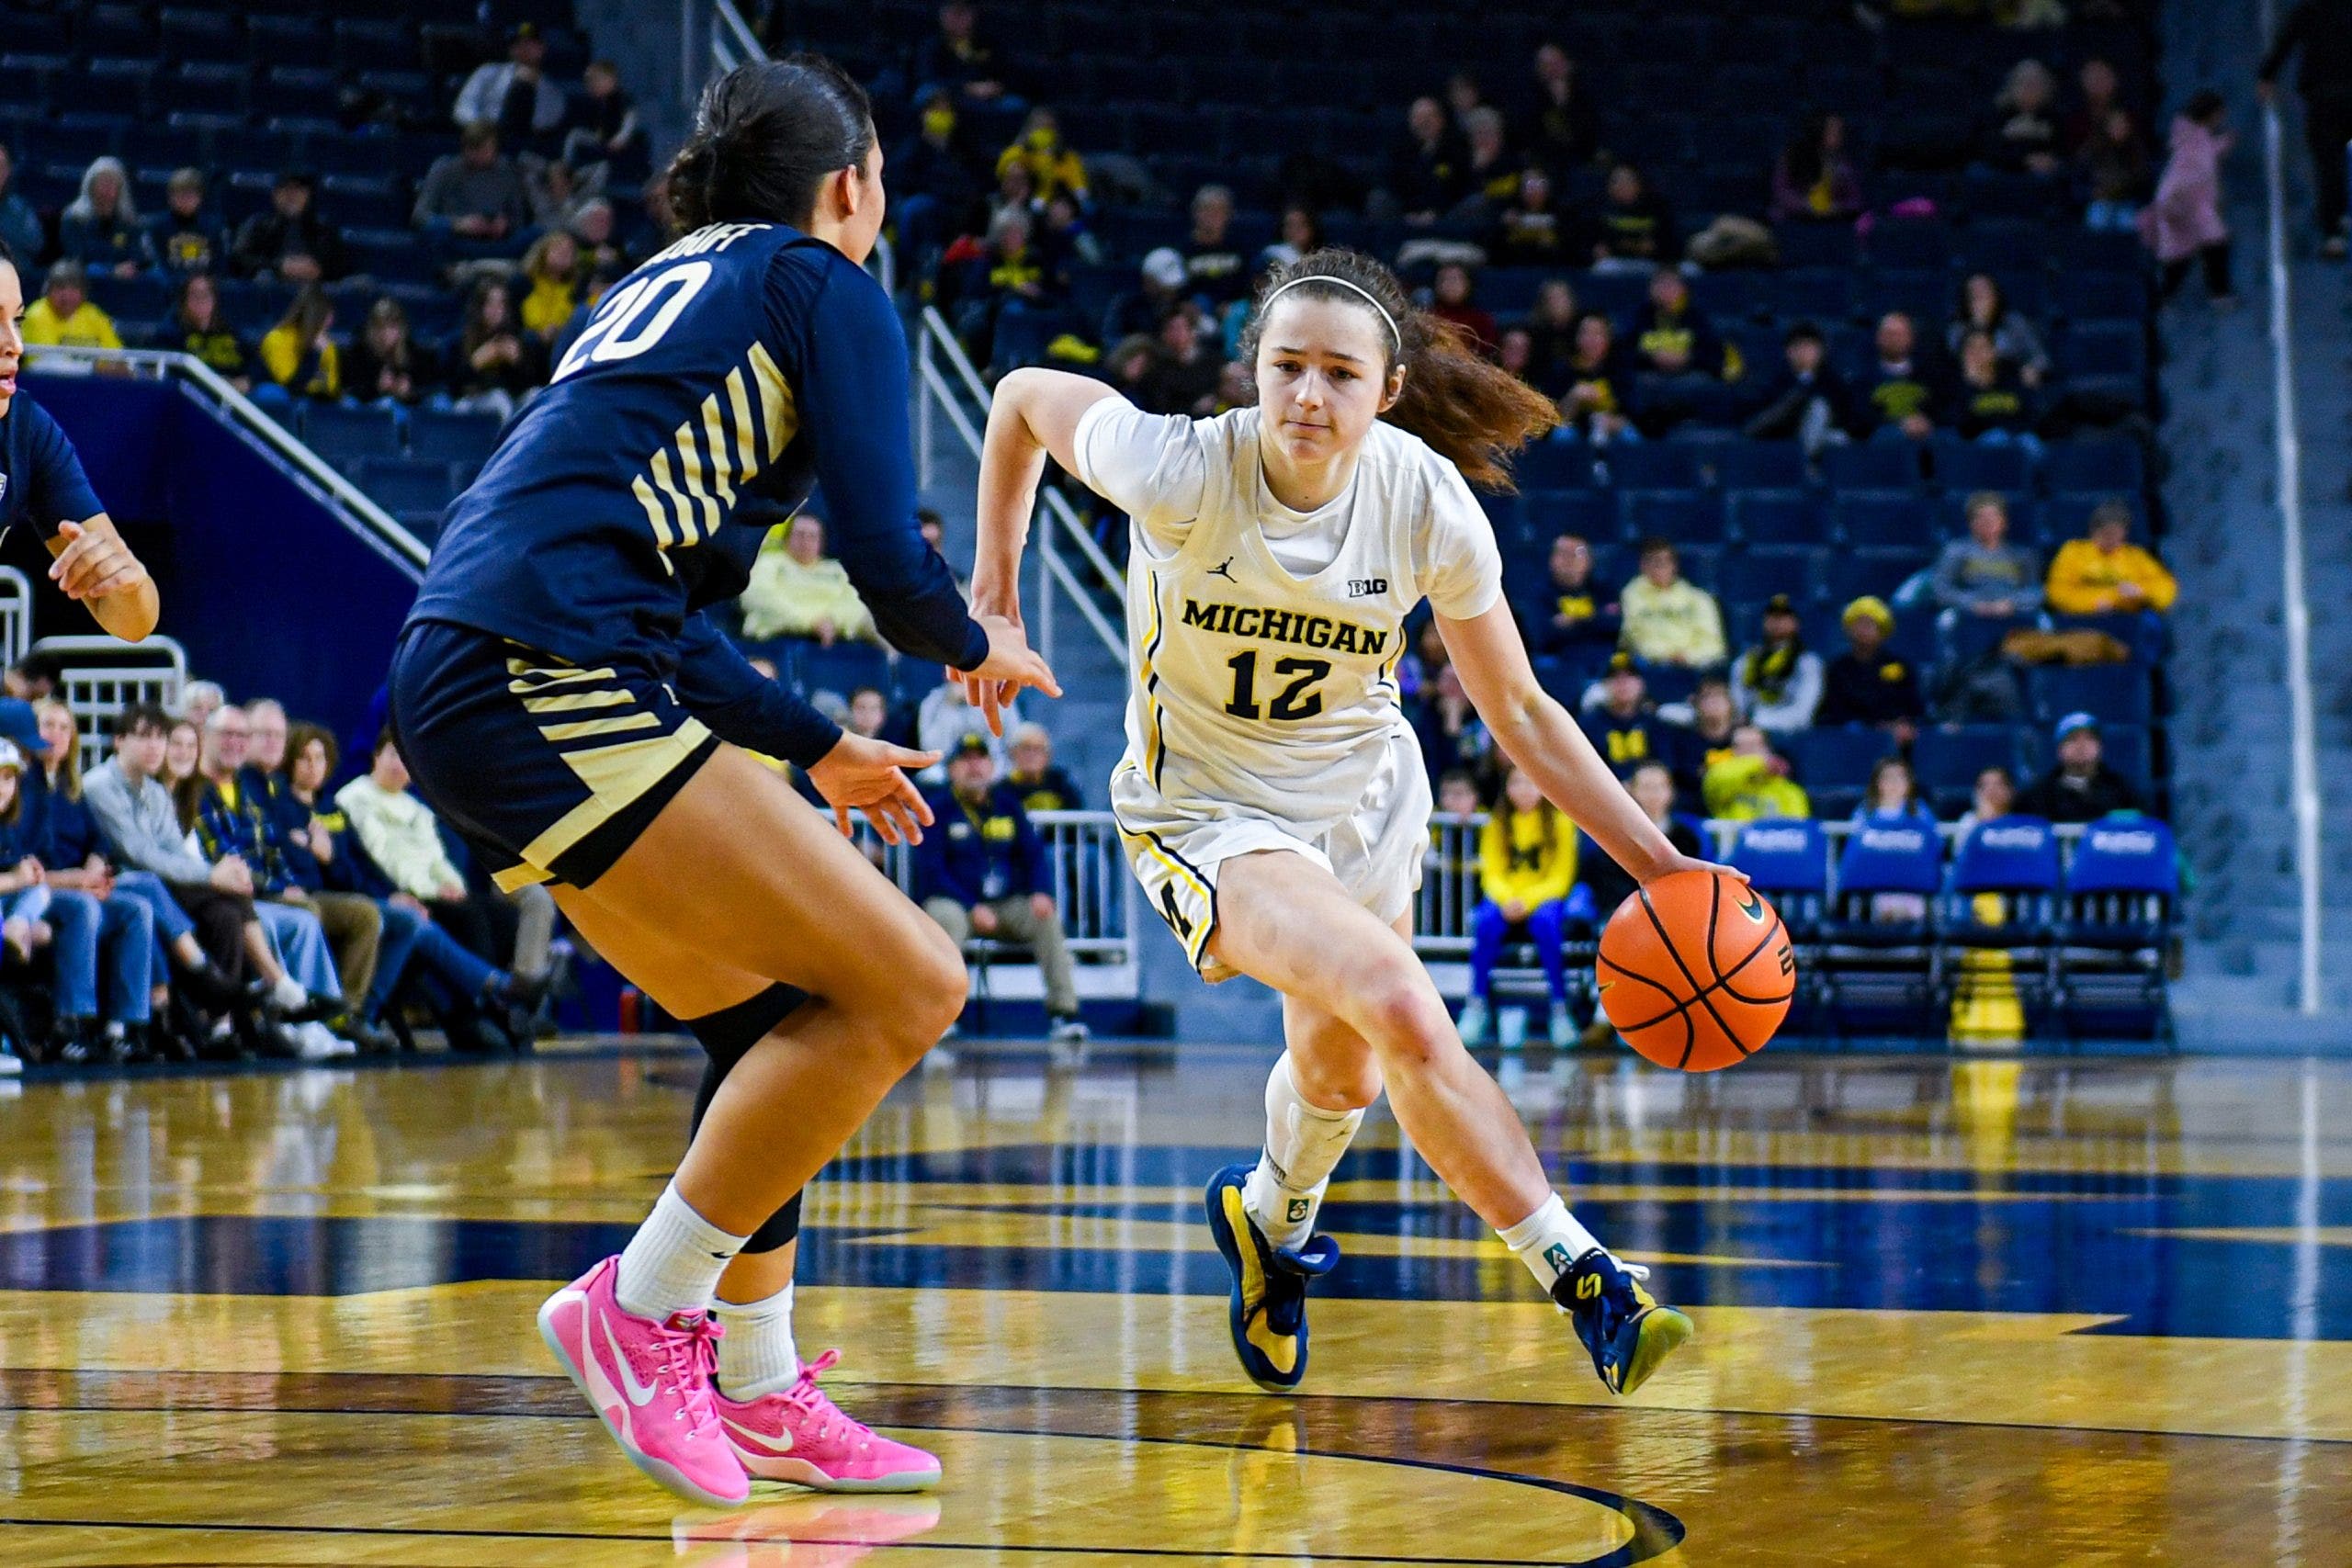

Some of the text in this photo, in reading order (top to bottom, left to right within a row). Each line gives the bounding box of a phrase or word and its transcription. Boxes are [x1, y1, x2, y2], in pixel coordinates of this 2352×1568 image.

[549, 261, 713, 385] 20
[1181, 598, 1389, 656] MICHIGAN
[1224, 648, 1332, 721] 12
